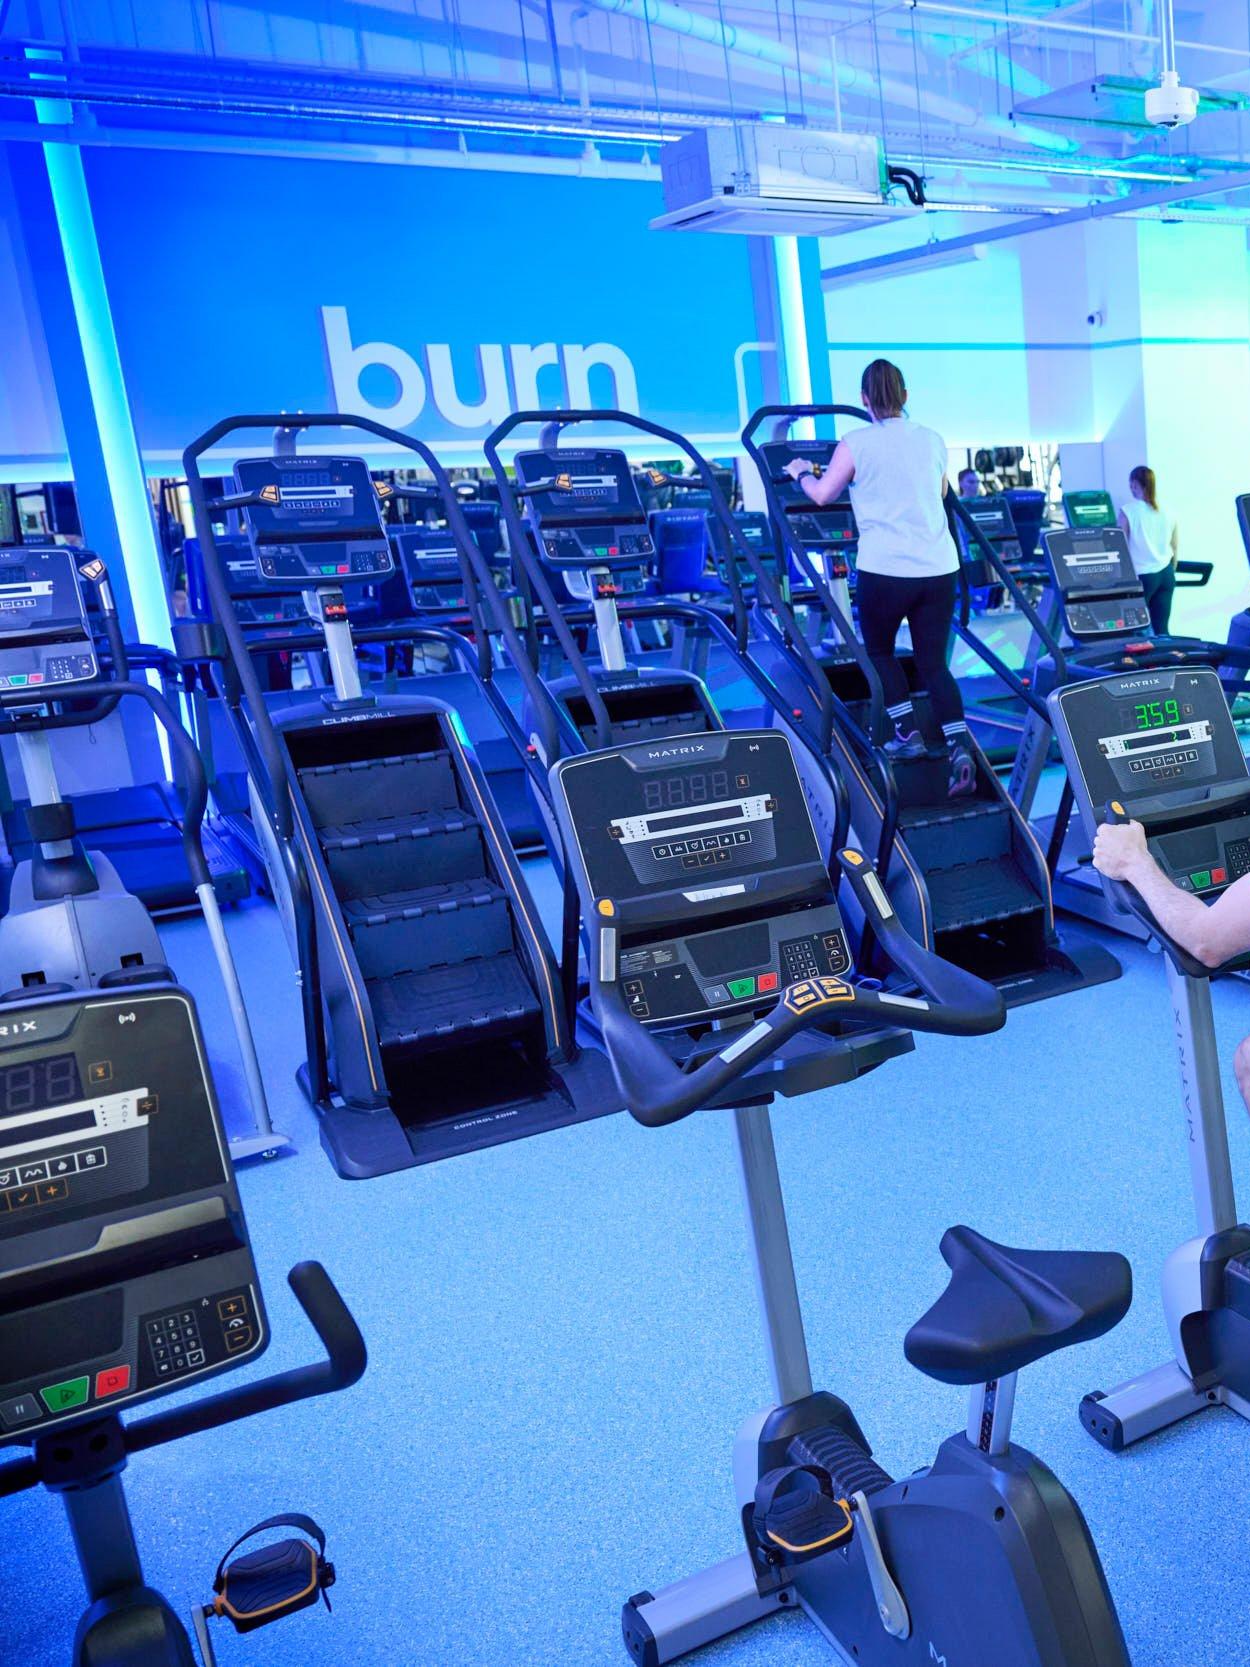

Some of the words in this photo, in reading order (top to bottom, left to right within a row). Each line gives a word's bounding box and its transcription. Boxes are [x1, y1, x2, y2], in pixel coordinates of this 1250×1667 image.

[322, 305, 640, 429] burn
[1120, 678, 1160, 689] MATRIX
[322, 712, 397, 725] CLIMBMILL
[648, 744, 705, 759] MATRIX
[453, 1116, 494, 1130] CONTROL
[495, 1110, 518, 1120] ZONE
